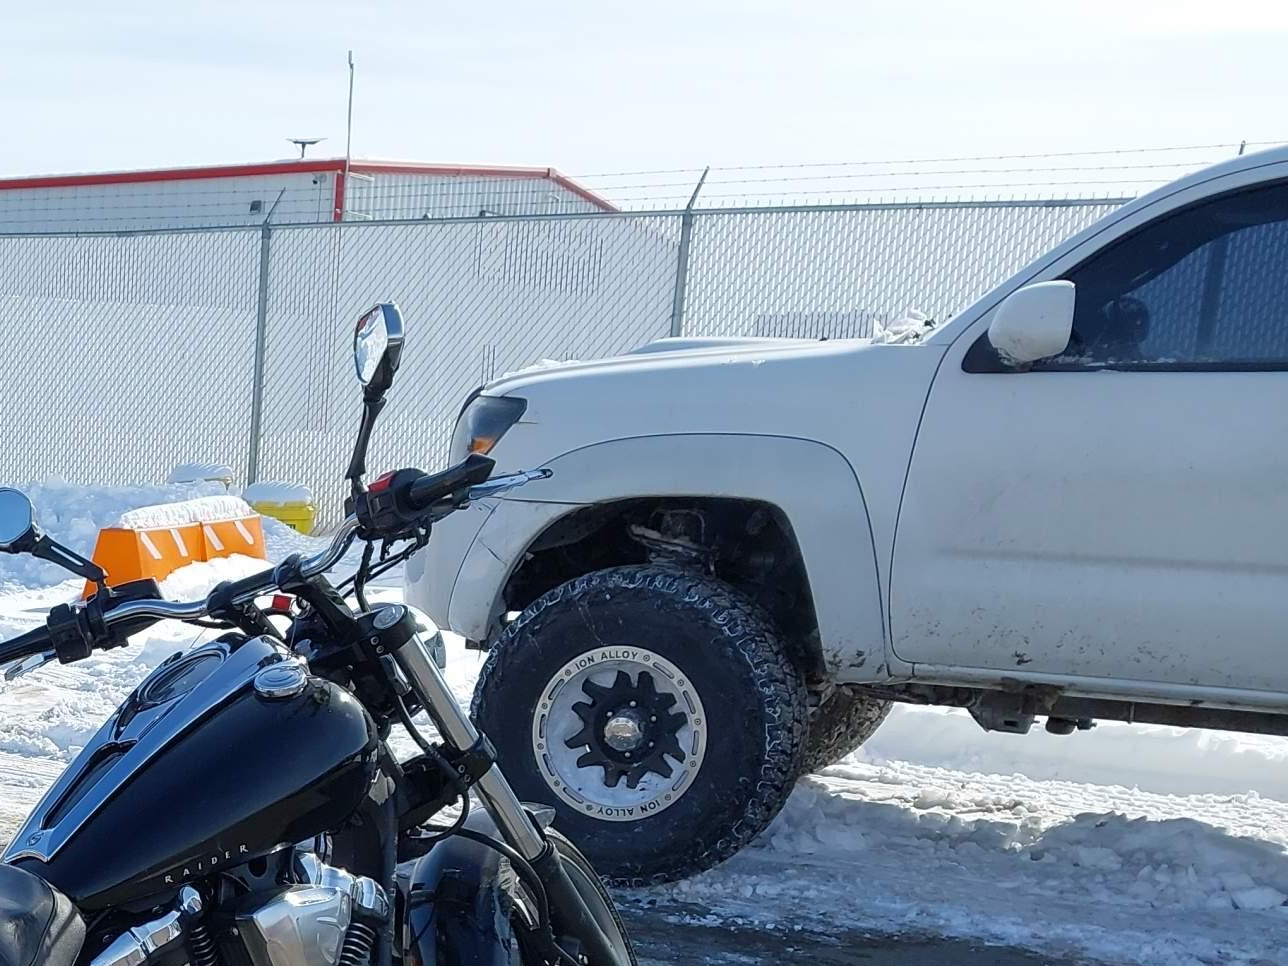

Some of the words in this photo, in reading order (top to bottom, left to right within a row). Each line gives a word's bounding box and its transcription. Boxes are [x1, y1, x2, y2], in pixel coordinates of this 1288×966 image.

[575, 655, 596, 671] ION
[600, 650, 639, 661] ALLOY
[596, 806, 634, 817] ALLOY
[639, 799, 661, 814] ION
[164, 843, 249, 884] RAIDER
